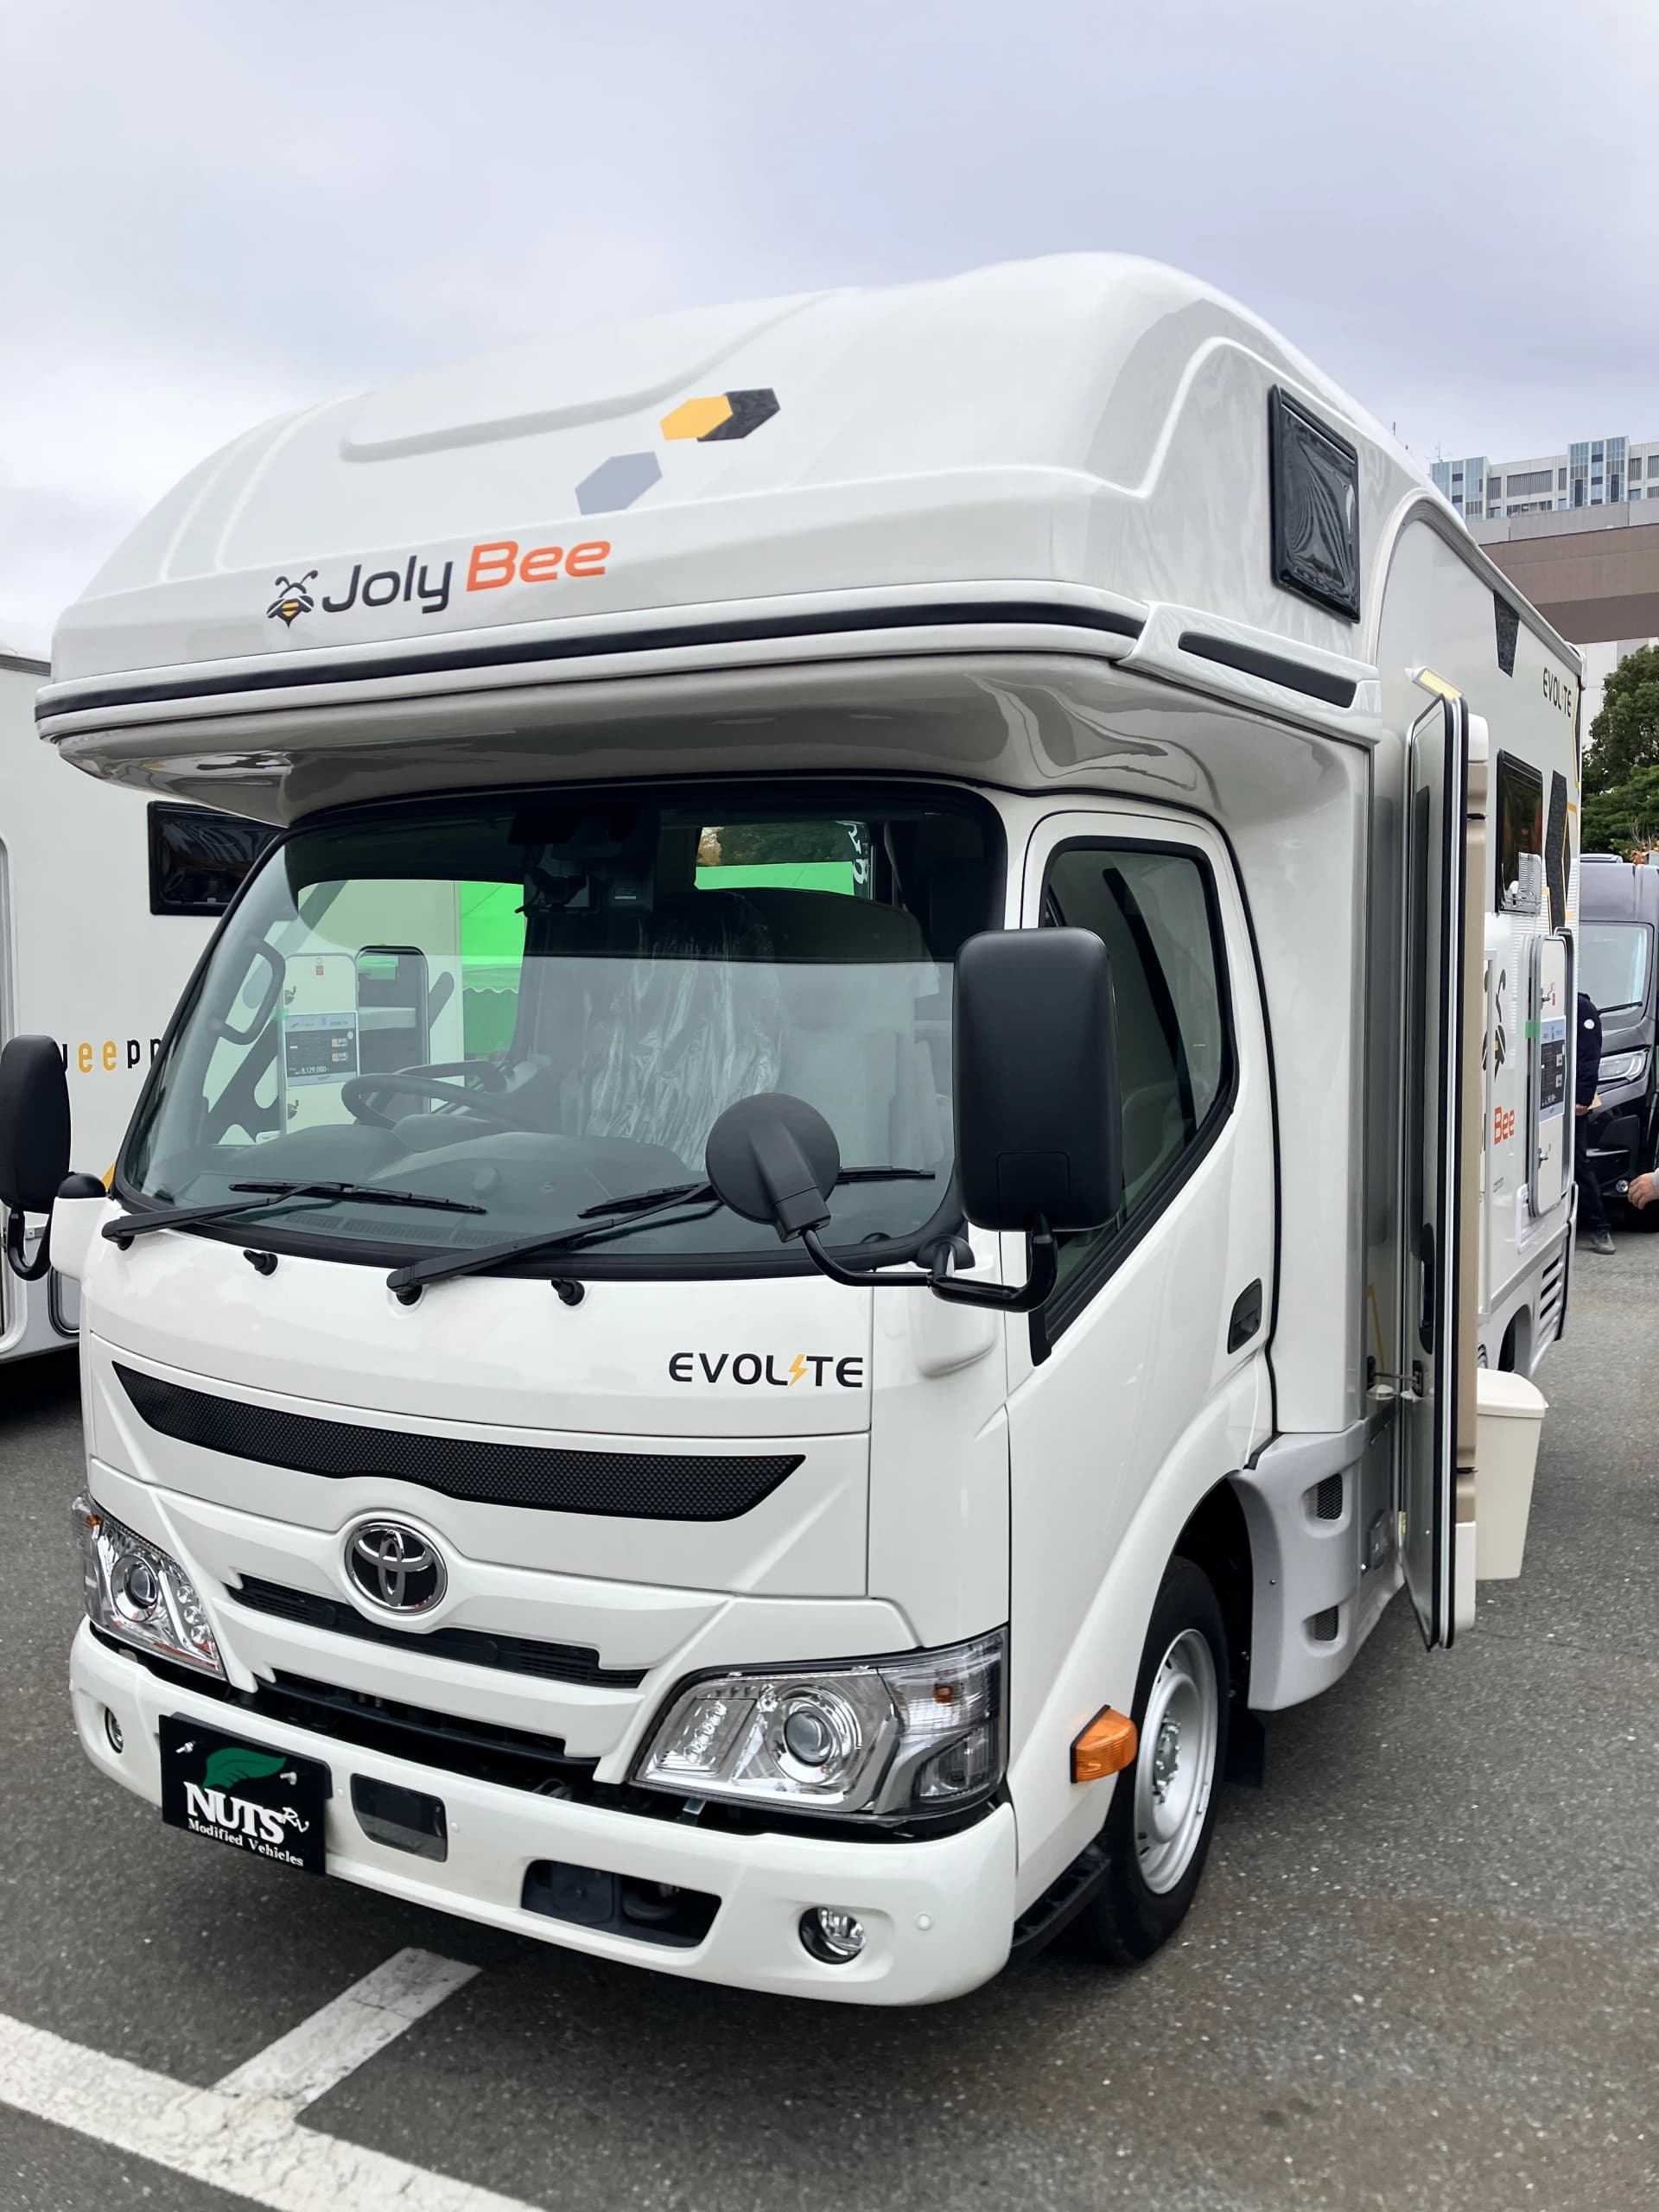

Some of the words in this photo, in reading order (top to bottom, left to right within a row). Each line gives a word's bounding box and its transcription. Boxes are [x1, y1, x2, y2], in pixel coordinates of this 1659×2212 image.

[322, 556, 453, 614] Joly
[466, 541, 611, 592] Bee
[1494, 1106, 1515, 1146] Bee
[183, 1781, 285, 1845] NUTS
[188, 1817, 243, 1847] Modified
[247, 1837, 303, 1866] Vehicles
